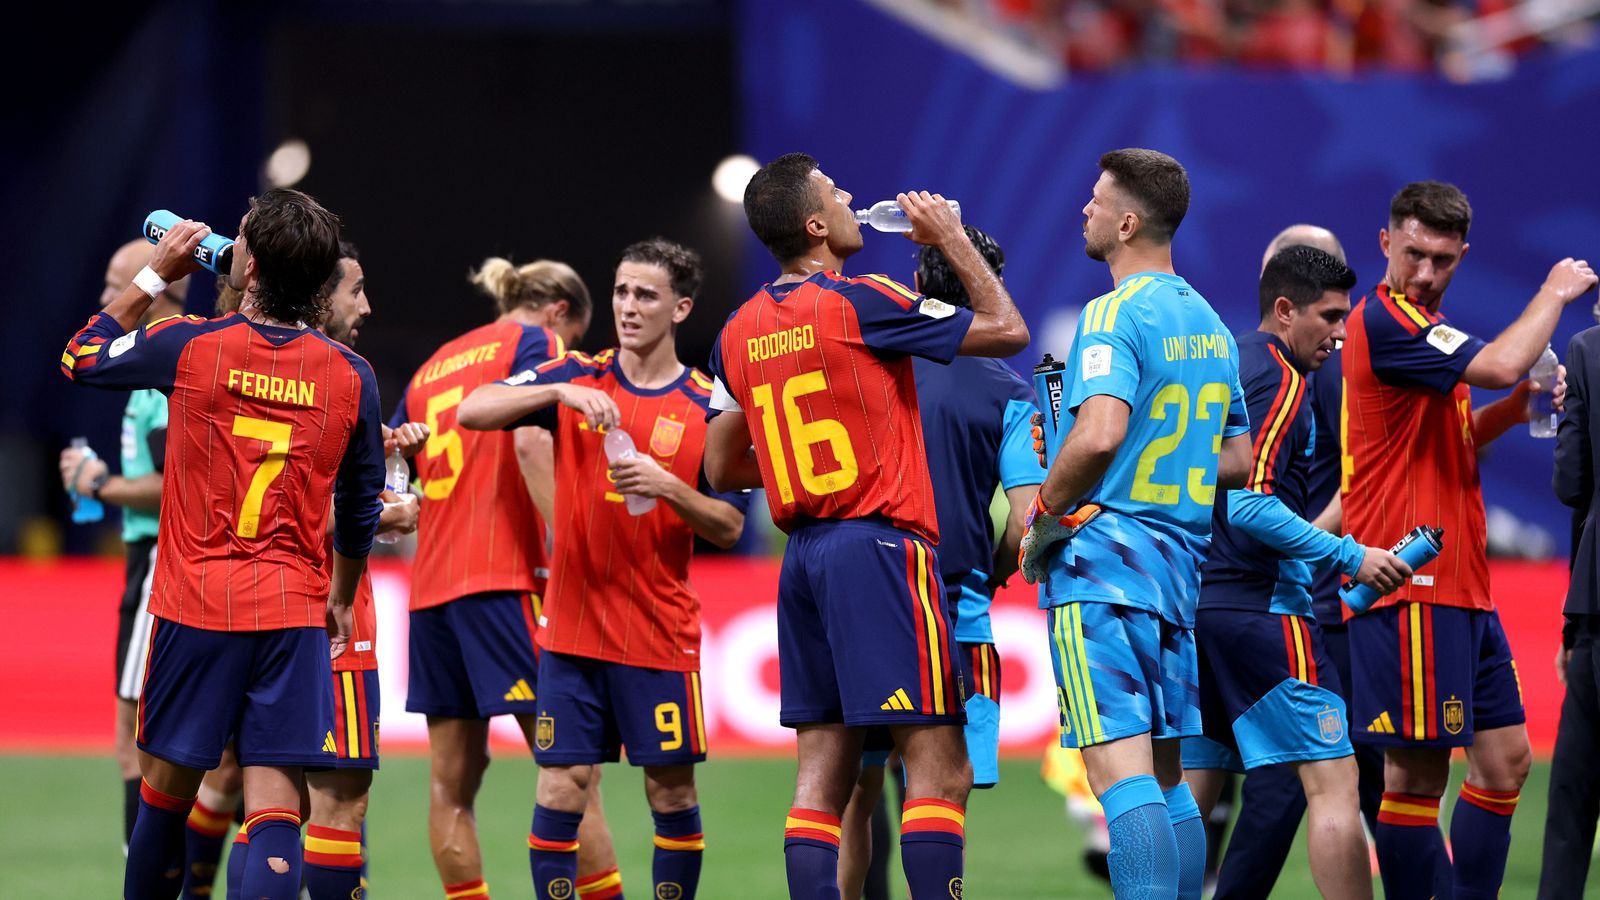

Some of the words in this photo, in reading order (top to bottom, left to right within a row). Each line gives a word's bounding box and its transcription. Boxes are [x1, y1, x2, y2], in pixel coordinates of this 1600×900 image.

[227, 369, 315, 407] FERRAN
[747, 324, 815, 363] RODRIGO
[232, 415, 293, 539] 7
[424, 386, 464, 500] 5
[751, 369, 859, 505] 16
[1129, 382, 1231, 506] 23
[655, 702, 682, 751] 9
